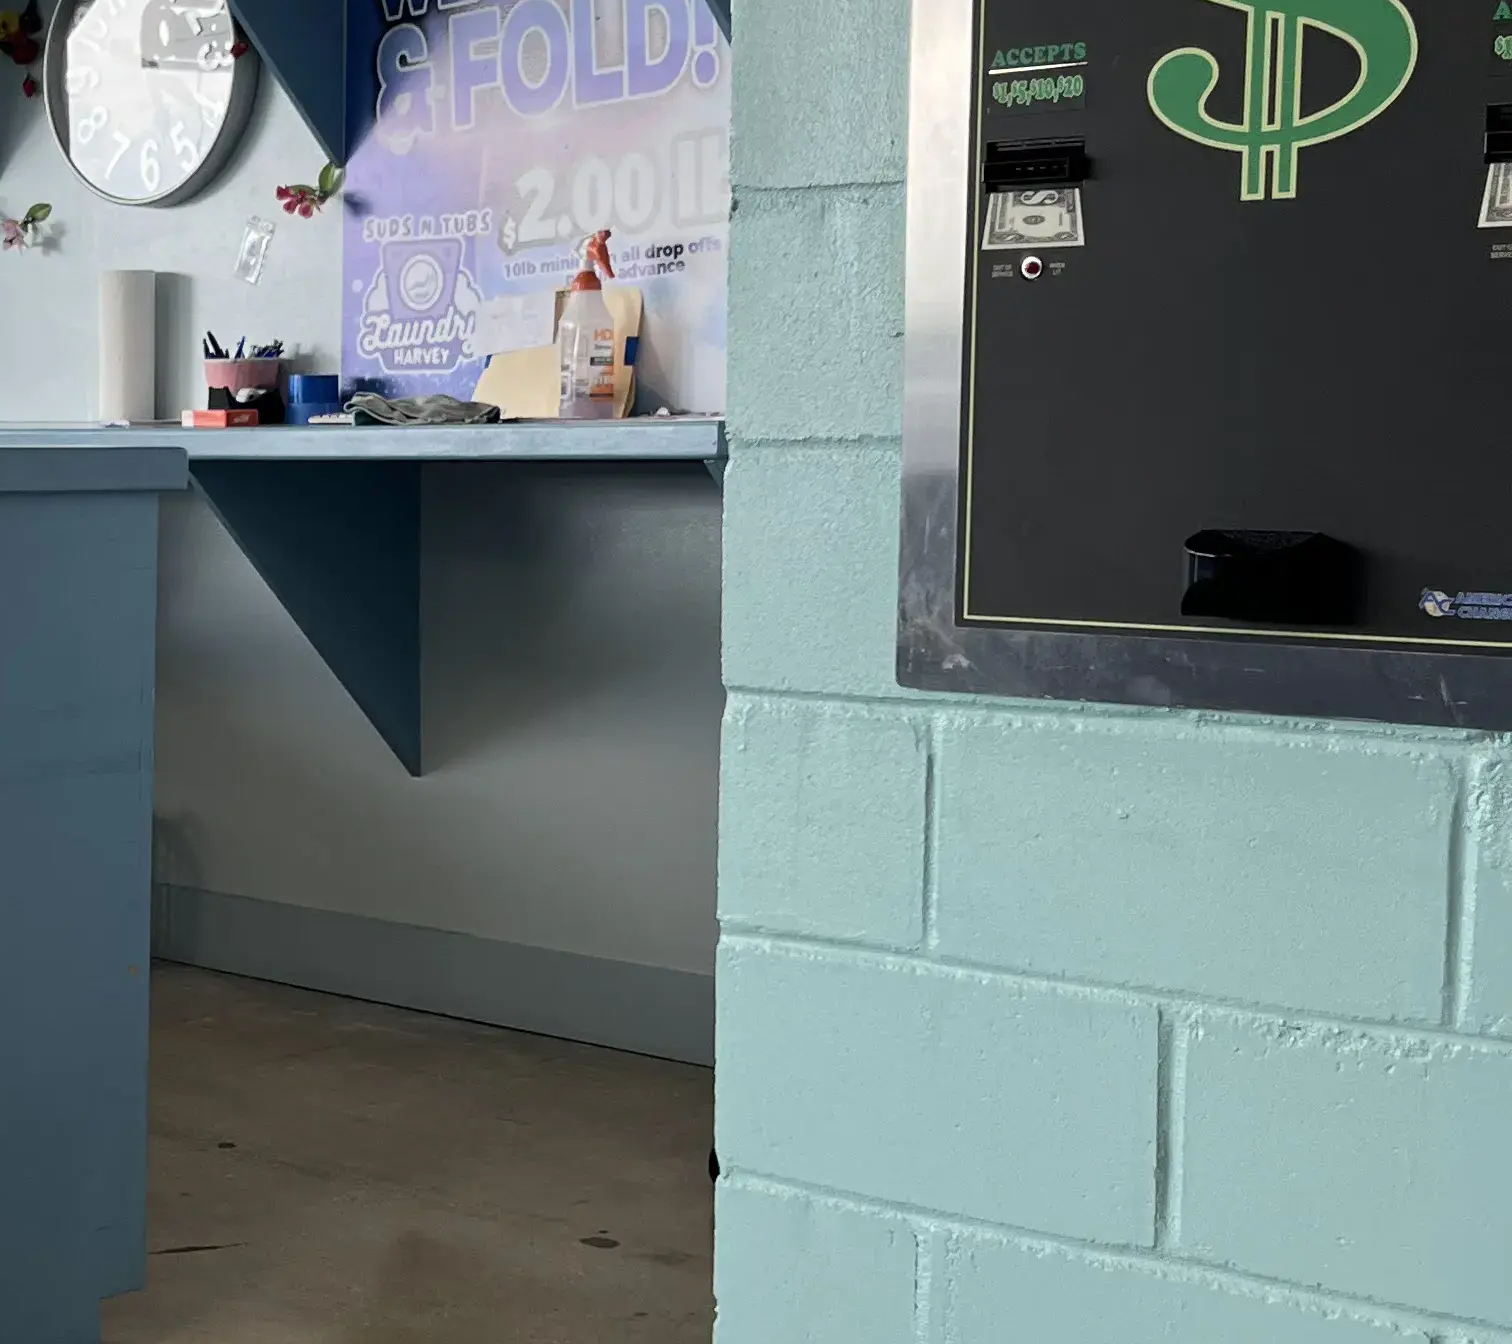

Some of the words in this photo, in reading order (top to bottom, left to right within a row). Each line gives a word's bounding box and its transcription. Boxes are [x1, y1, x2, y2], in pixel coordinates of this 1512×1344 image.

[991, 42, 1087, 68] ACCEPTS
[376, 24, 440, 155] &
[365, 215, 412, 242] SUDS
[420, 217, 433, 236] N
[441, 209, 493, 236] TUBS
[504, 261, 536, 278] 10lb
[621, 246, 640, 263] all
[645, 242, 684, 261] drop
[618, 259, 686, 279] advance
[363, 306, 476, 354] Laundry
[394, 347, 449, 365] HARVEY
